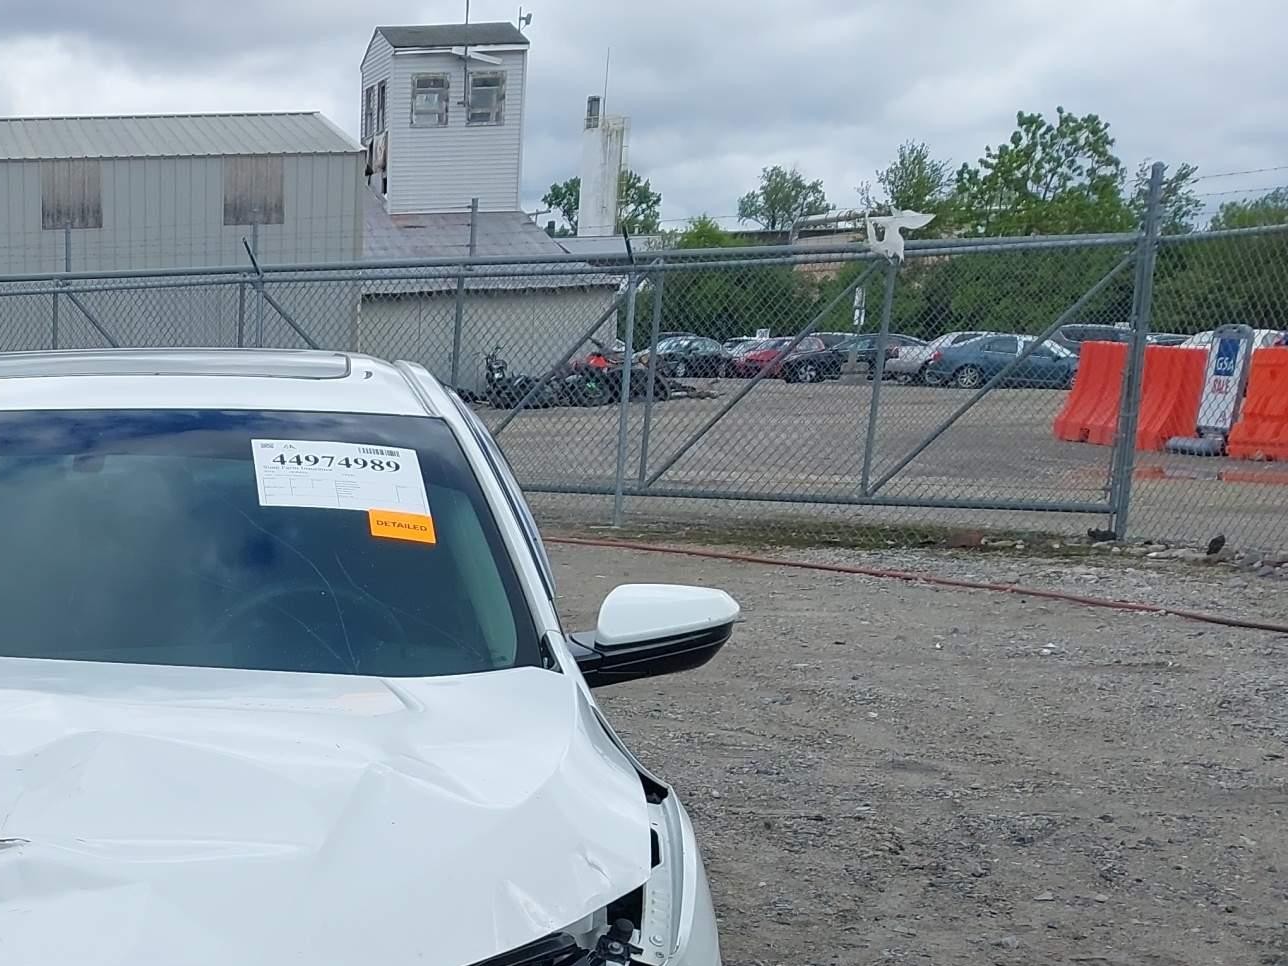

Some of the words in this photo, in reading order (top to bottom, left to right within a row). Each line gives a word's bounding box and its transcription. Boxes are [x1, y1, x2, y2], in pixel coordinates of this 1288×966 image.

[1216, 356, 1234, 371] GSA
[272, 453, 400, 472] 44974989
[376, 520, 428, 532] DETAILED
